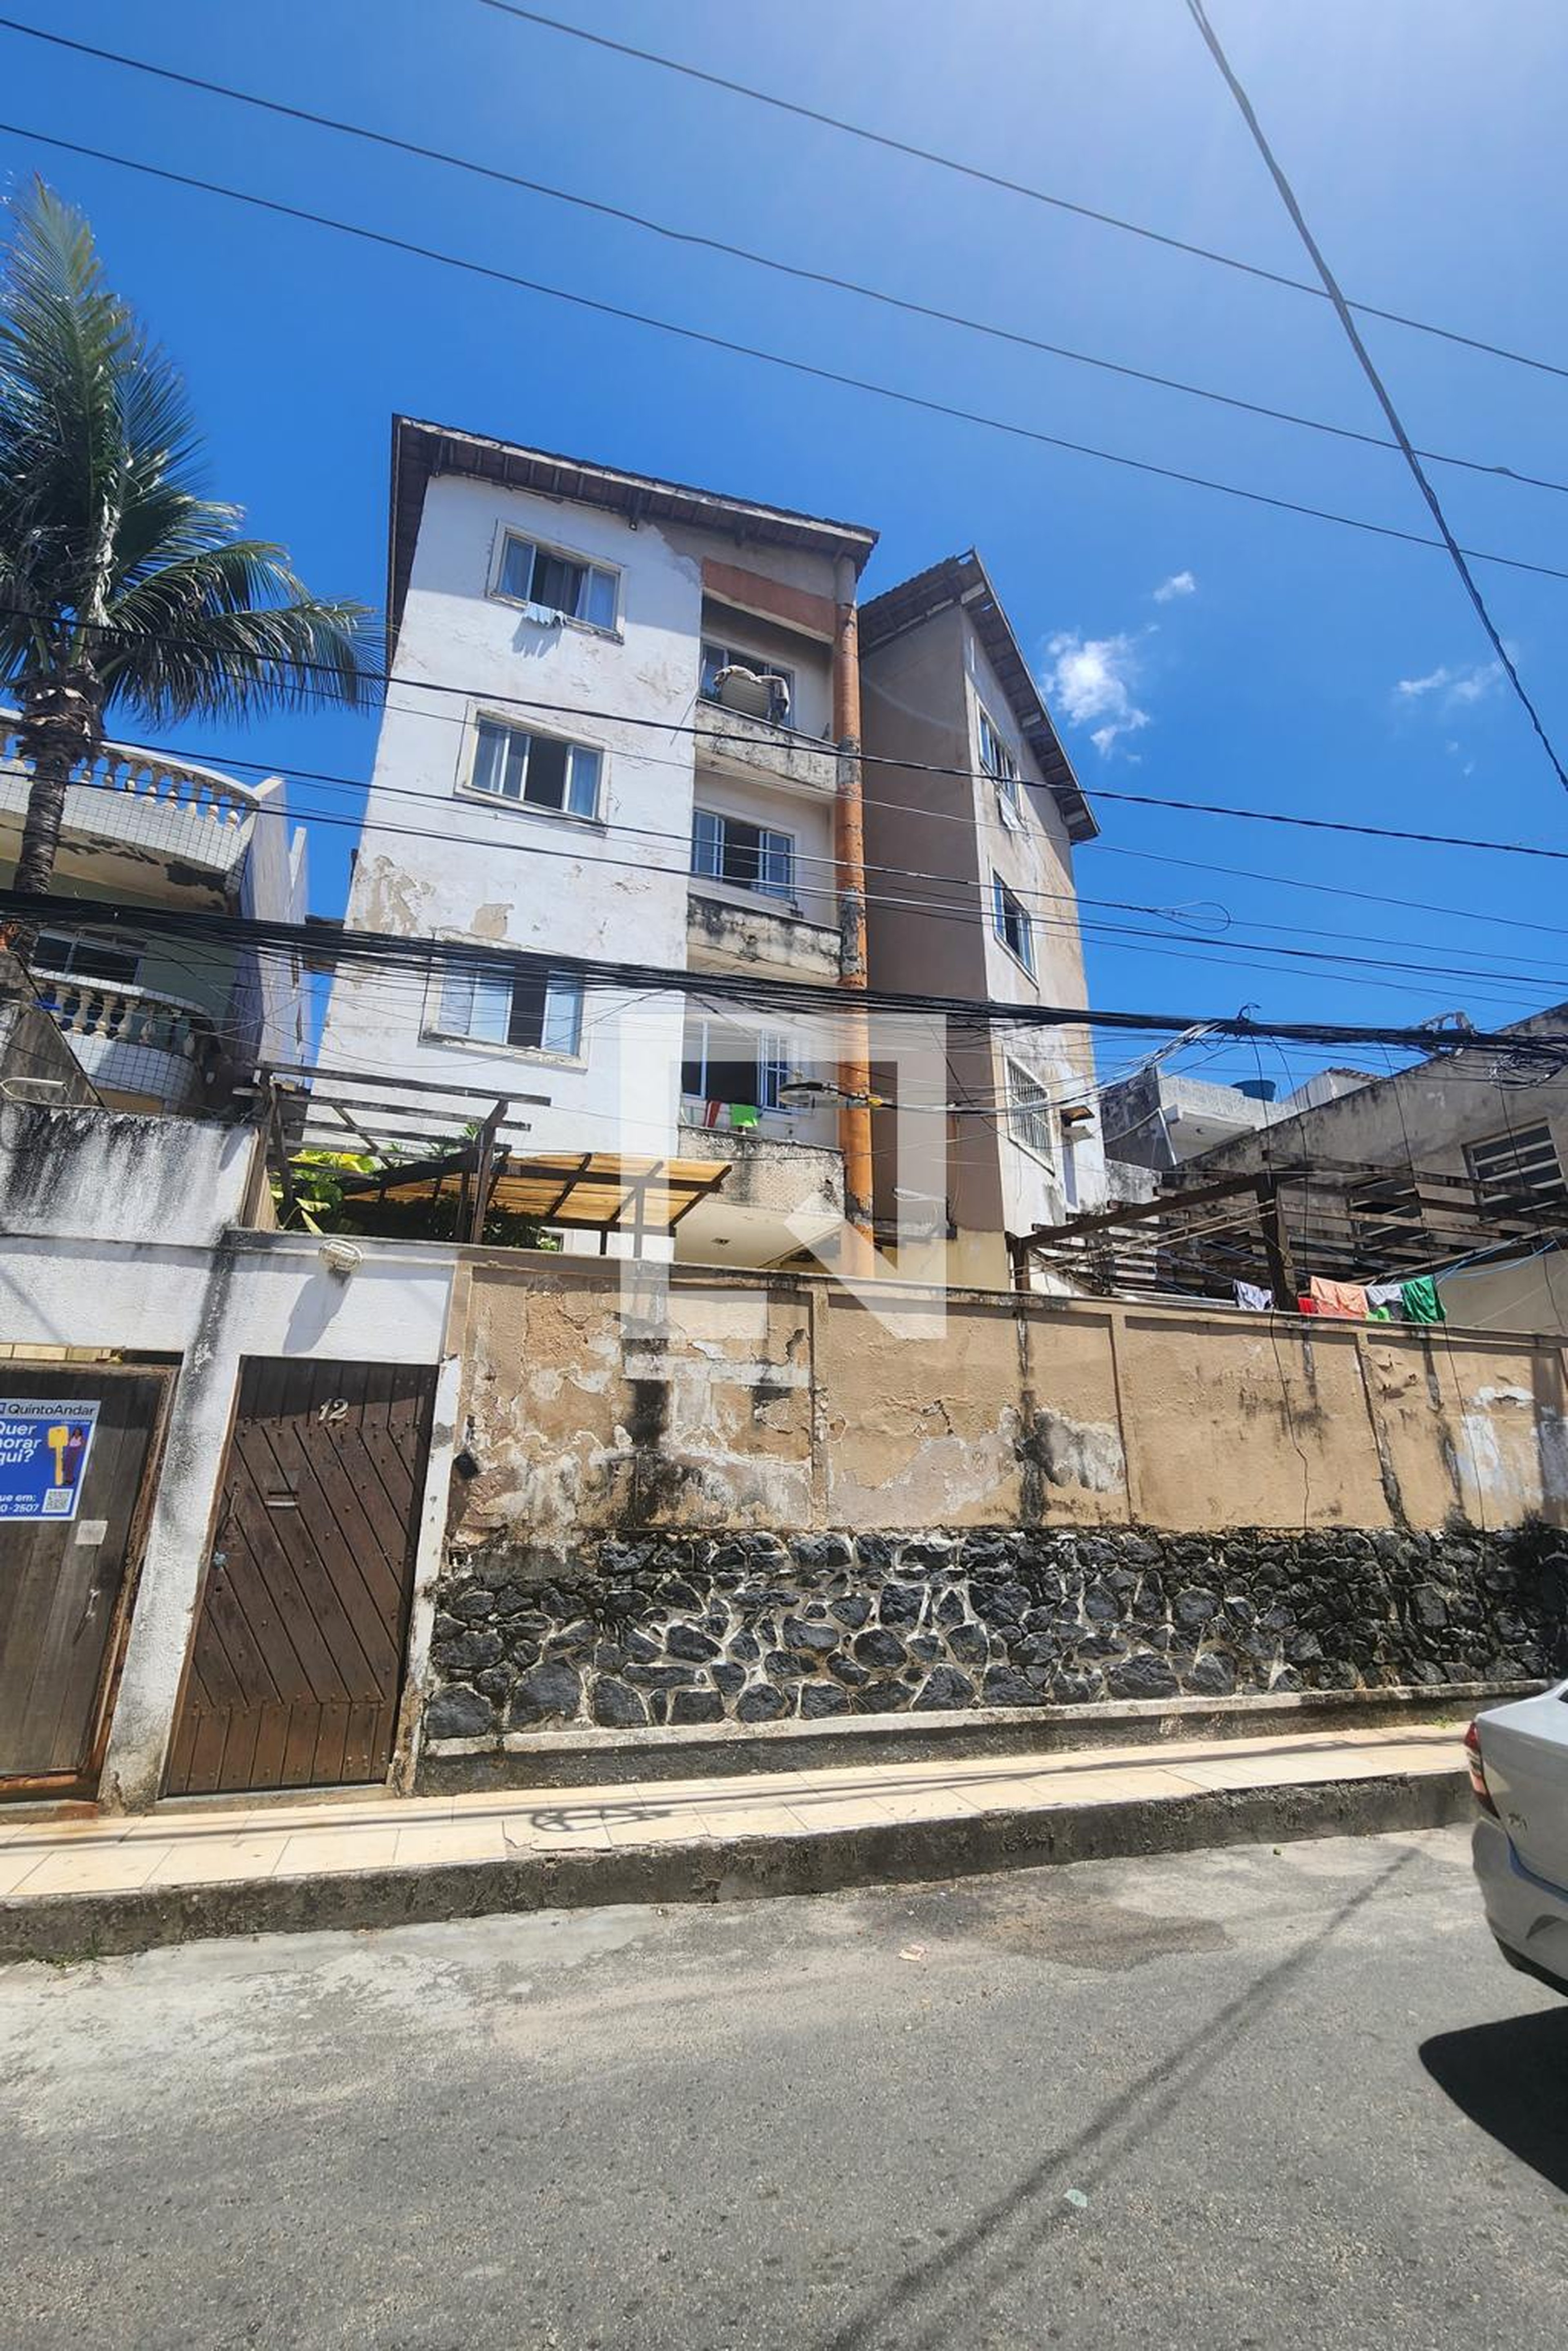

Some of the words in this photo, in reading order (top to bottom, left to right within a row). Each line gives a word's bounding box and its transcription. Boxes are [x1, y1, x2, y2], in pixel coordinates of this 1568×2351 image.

[8, 1403, 94, 1416] QuintoAndar
[318, 1398, 348, 1420] 12
[0, 1438, 42, 1449] orar
